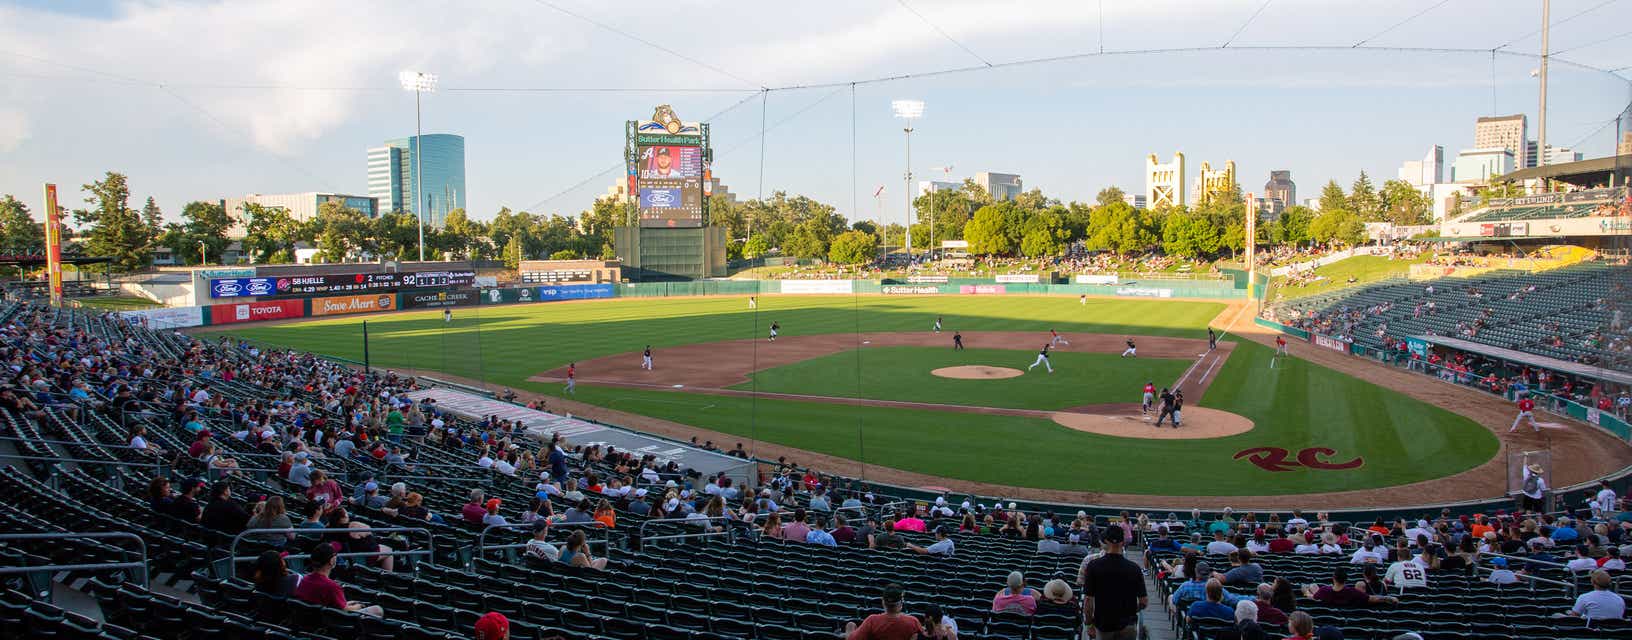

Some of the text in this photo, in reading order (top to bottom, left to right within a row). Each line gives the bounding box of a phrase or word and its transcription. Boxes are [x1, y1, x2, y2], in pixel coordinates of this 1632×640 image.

[403, 275, 415, 285] 92
[890, 286, 939, 294] Sutter Health
[324, 297, 375, 312] Save Mart
[252, 306, 282, 315] TOYOTA
[1232, 446, 1365, 472] RC
[1403, 569, 1424, 581] 62
